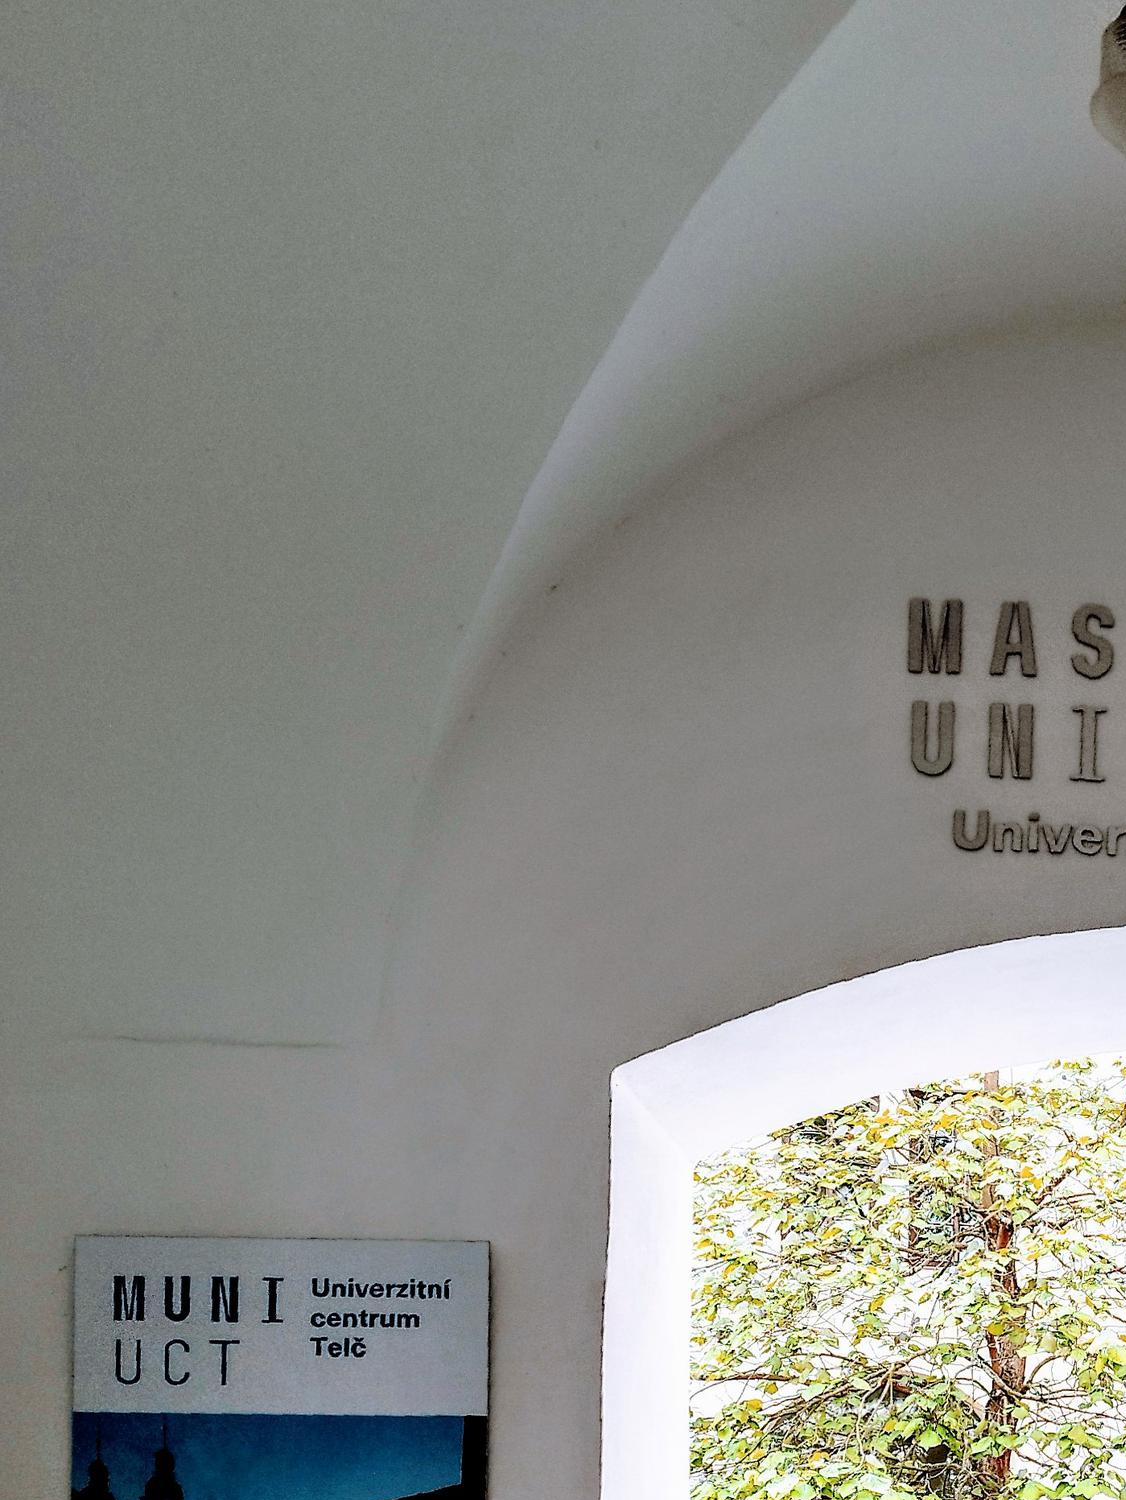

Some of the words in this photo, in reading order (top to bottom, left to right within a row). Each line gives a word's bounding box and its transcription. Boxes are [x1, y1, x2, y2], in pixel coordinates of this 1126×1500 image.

[113, 1275, 284, 1323] MUNI
[311, 1278, 451, 1299] Univerzitní
[310, 1309, 420, 1329] centrum
[310, 1336, 367, 1358] Telč
[115, 1339, 240, 1386] UCT
